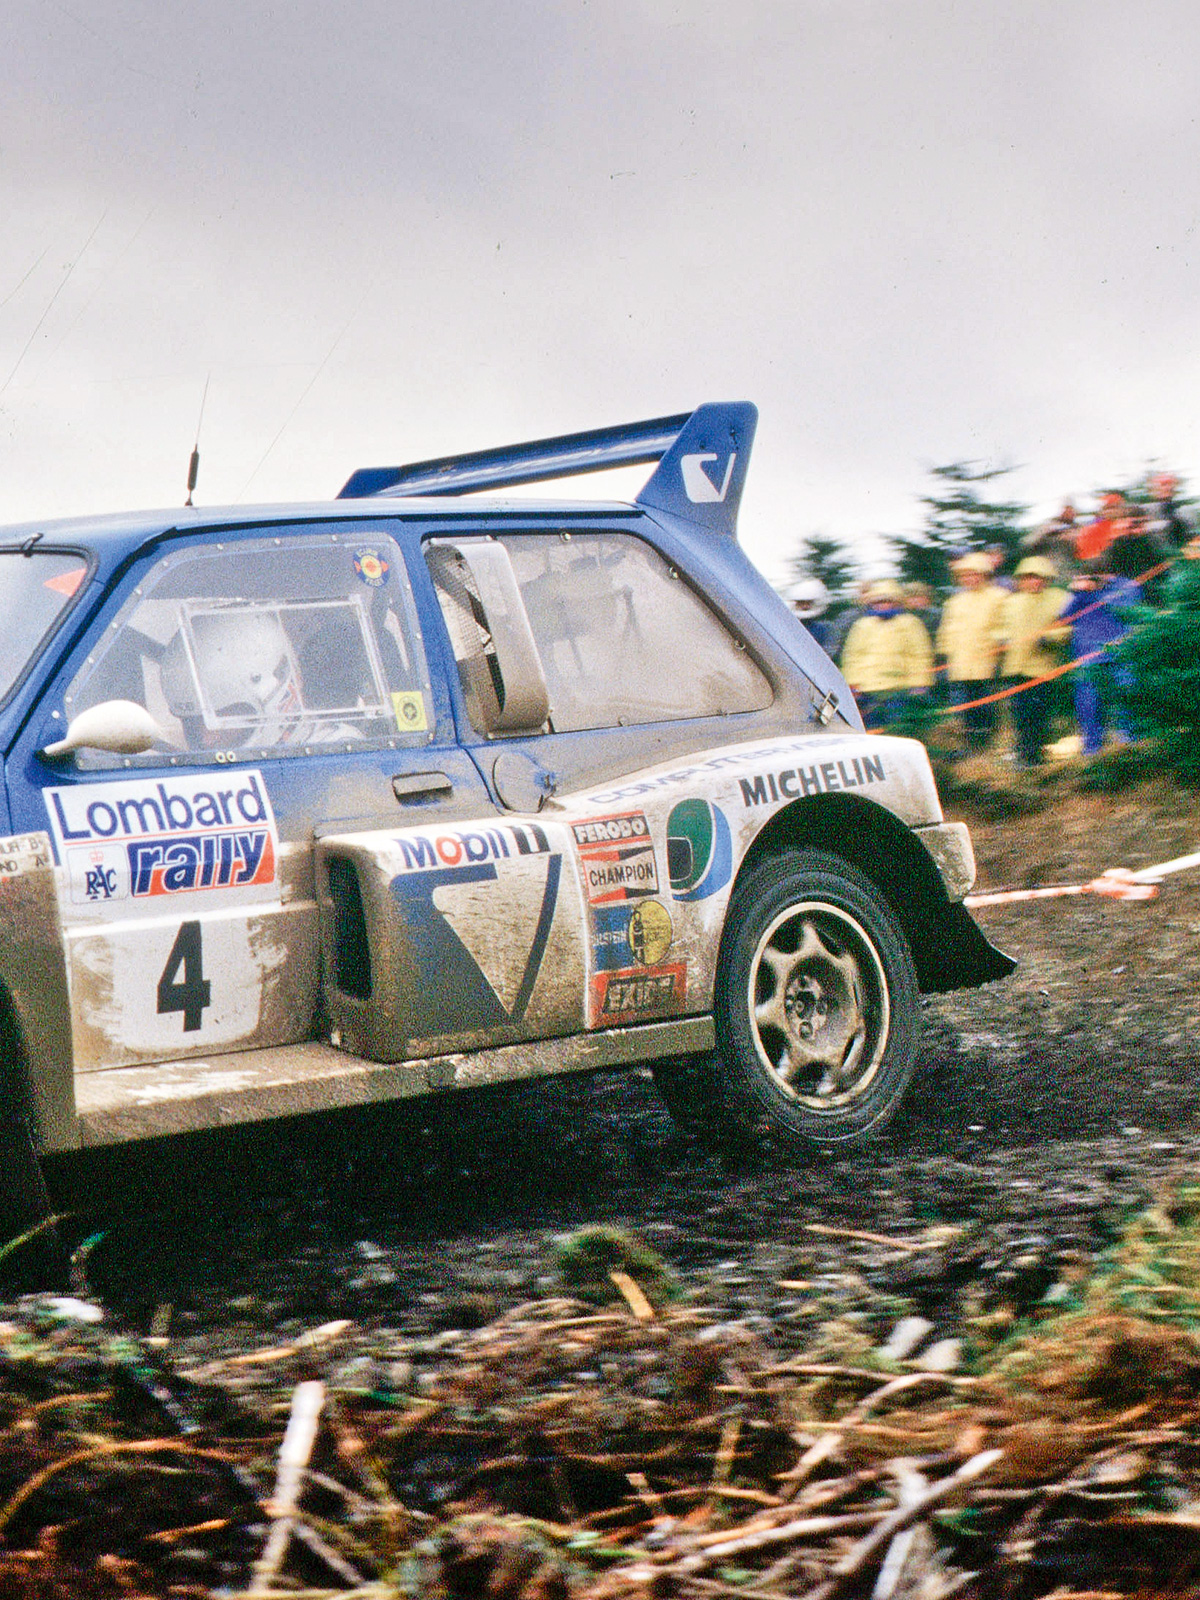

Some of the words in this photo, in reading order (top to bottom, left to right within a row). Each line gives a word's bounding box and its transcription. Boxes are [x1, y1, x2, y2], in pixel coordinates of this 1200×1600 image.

[738, 754, 887, 807] MICHELIN
[51, 775, 269, 840] Lombard
[573, 817, 646, 845] FERODO
[134, 831, 270, 897] rally
[392, 826, 511, 869] Mobil
[588, 862, 655, 887] CHAMPION
[156, 919, 211, 1032] 4
